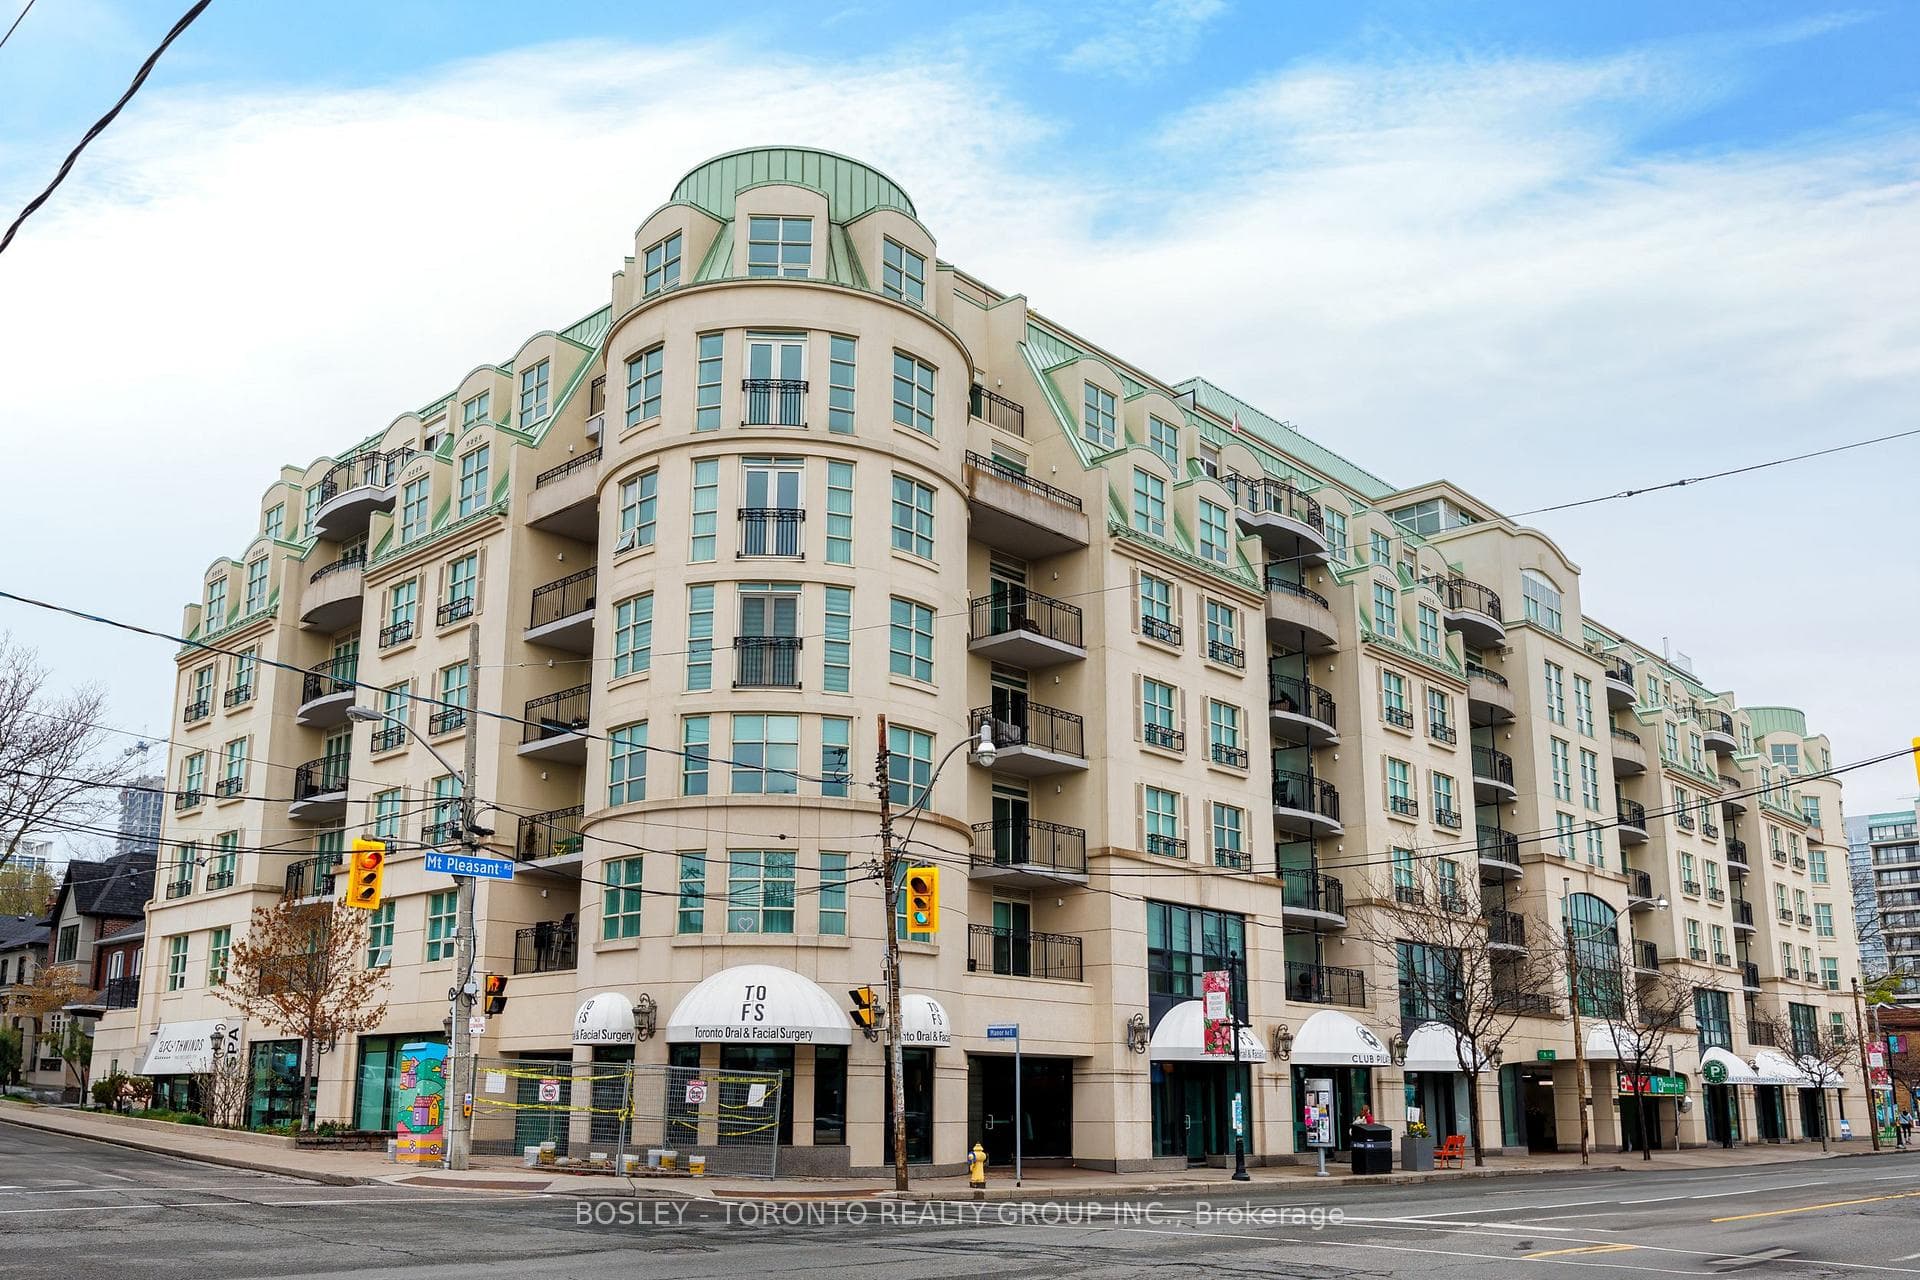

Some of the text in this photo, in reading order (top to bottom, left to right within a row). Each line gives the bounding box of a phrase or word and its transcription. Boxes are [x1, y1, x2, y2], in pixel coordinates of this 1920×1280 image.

[427, 855, 512, 875] Mt Pleasant Rd
[744, 985, 767, 1001] TO
[741, 1003, 765, 1022] FS
[926, 1002, 940, 1013] TO
[931, 1013, 943, 1026] FS
[580, 1028, 601, 1040] Facial
[601, 1028, 635, 1043] Surgery
[694, 1026, 814, 1042] Toronto Oral & Facial Surgery
[916, 1030, 932, 1041] Oral
[932, 1031, 938, 1042] &
[1352, 1054, 1374, 1063] CLUB
[1710, 1066, 1720, 1077] P
